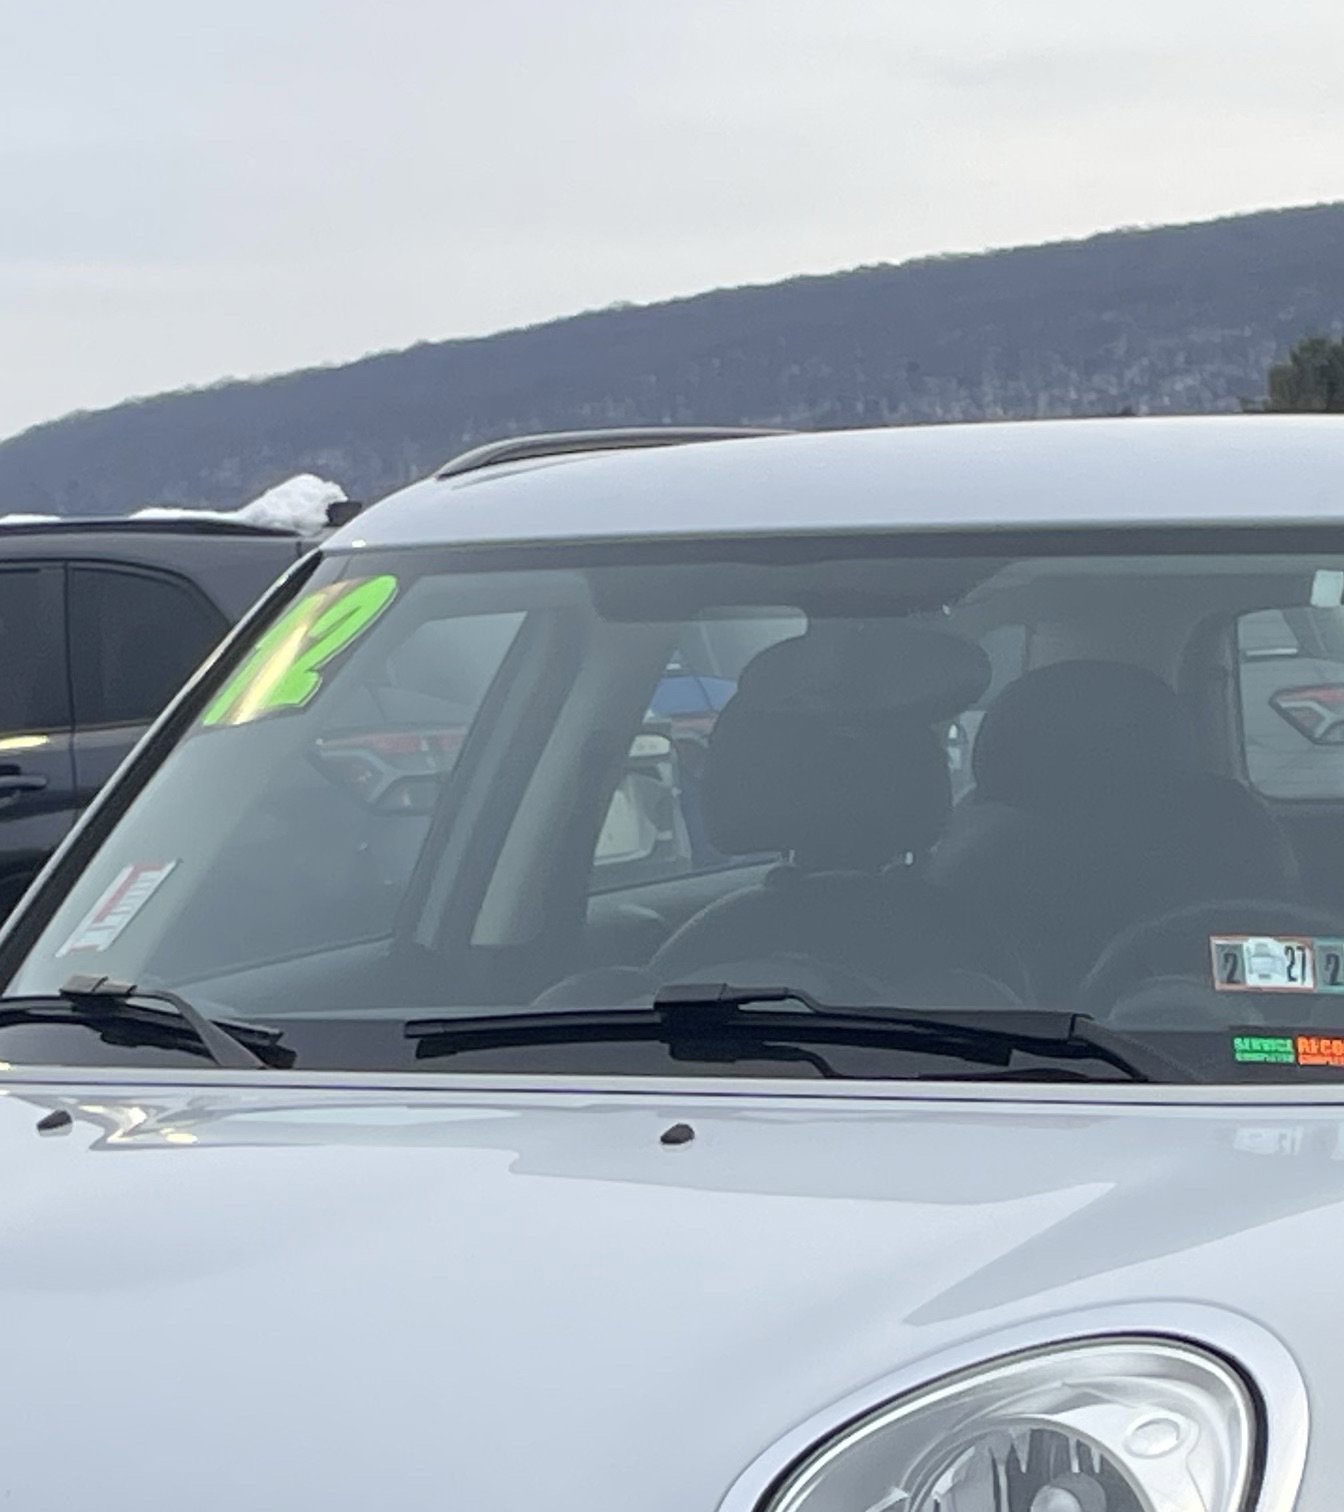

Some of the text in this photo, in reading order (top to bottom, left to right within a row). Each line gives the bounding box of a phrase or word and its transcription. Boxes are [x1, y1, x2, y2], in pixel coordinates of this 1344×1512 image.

[1223, 952, 1241, 985] 2
[1283, 944, 1308, 986] 27
[1324, 953, 1343, 986] 2
